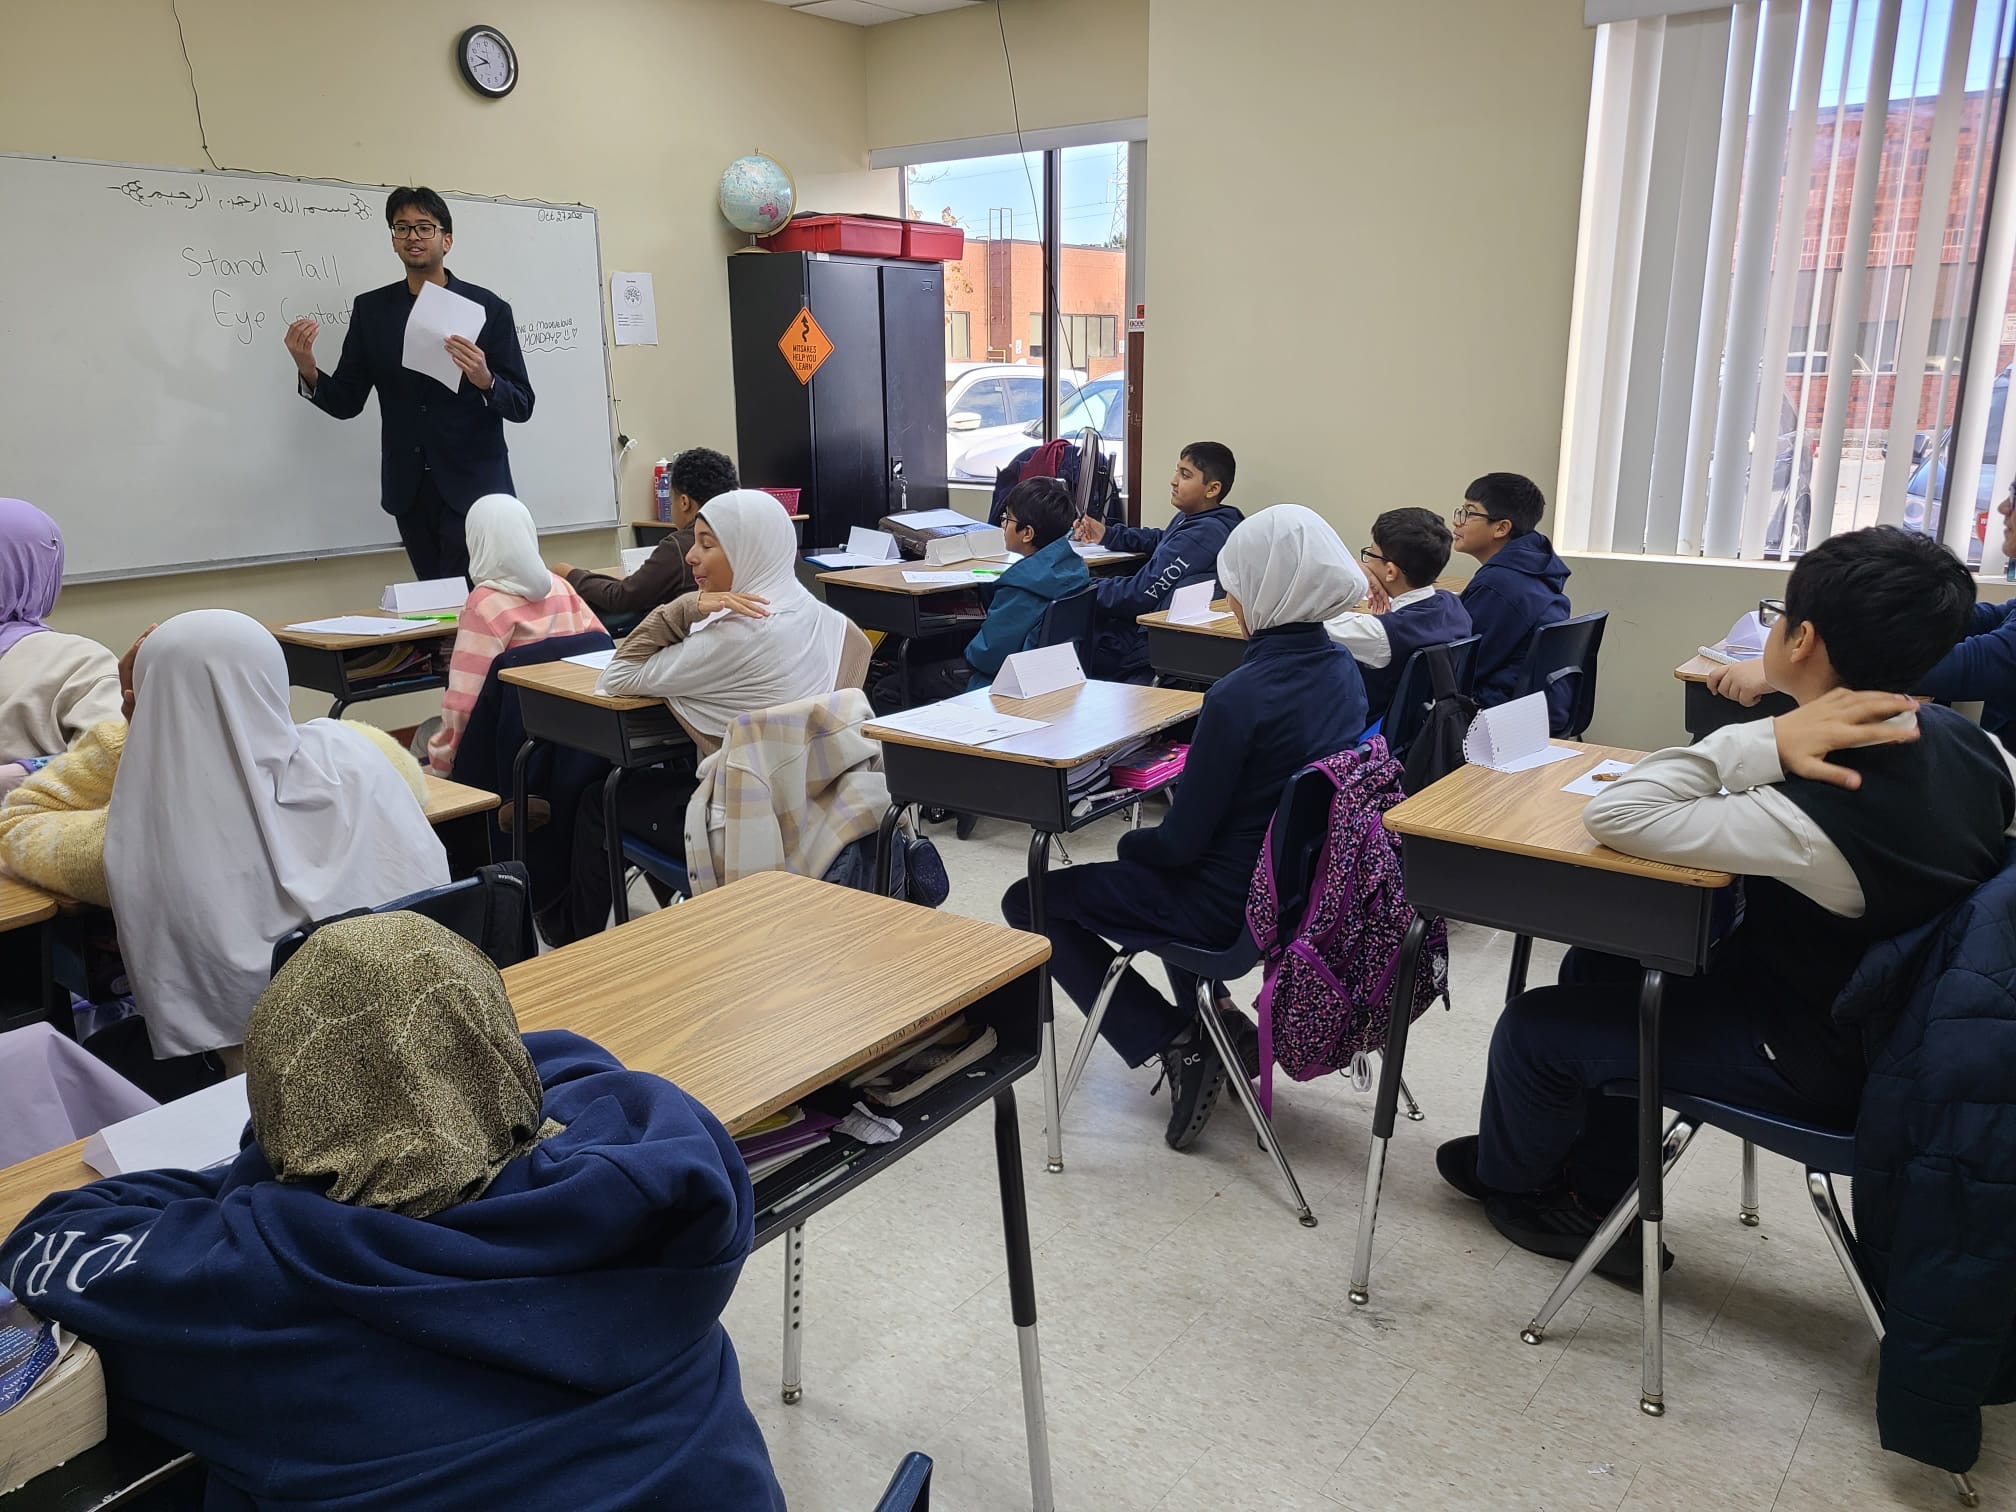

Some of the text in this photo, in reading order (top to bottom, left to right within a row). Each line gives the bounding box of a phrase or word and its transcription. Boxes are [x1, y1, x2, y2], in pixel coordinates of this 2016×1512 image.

[147, 182, 211, 209] الرحيم
[273, 195, 300, 214] الله
[303, 200, 350, 217] بسم
[537, 208, 555, 222] Oct
[181, 247, 341, 286] Stand Tall
[212, 289, 267, 345] Eye
[793, 353, 816, 362] HELP YOU
[796, 362, 812, 370] LEARN
[1144, 556, 1191, 600] IQRA
